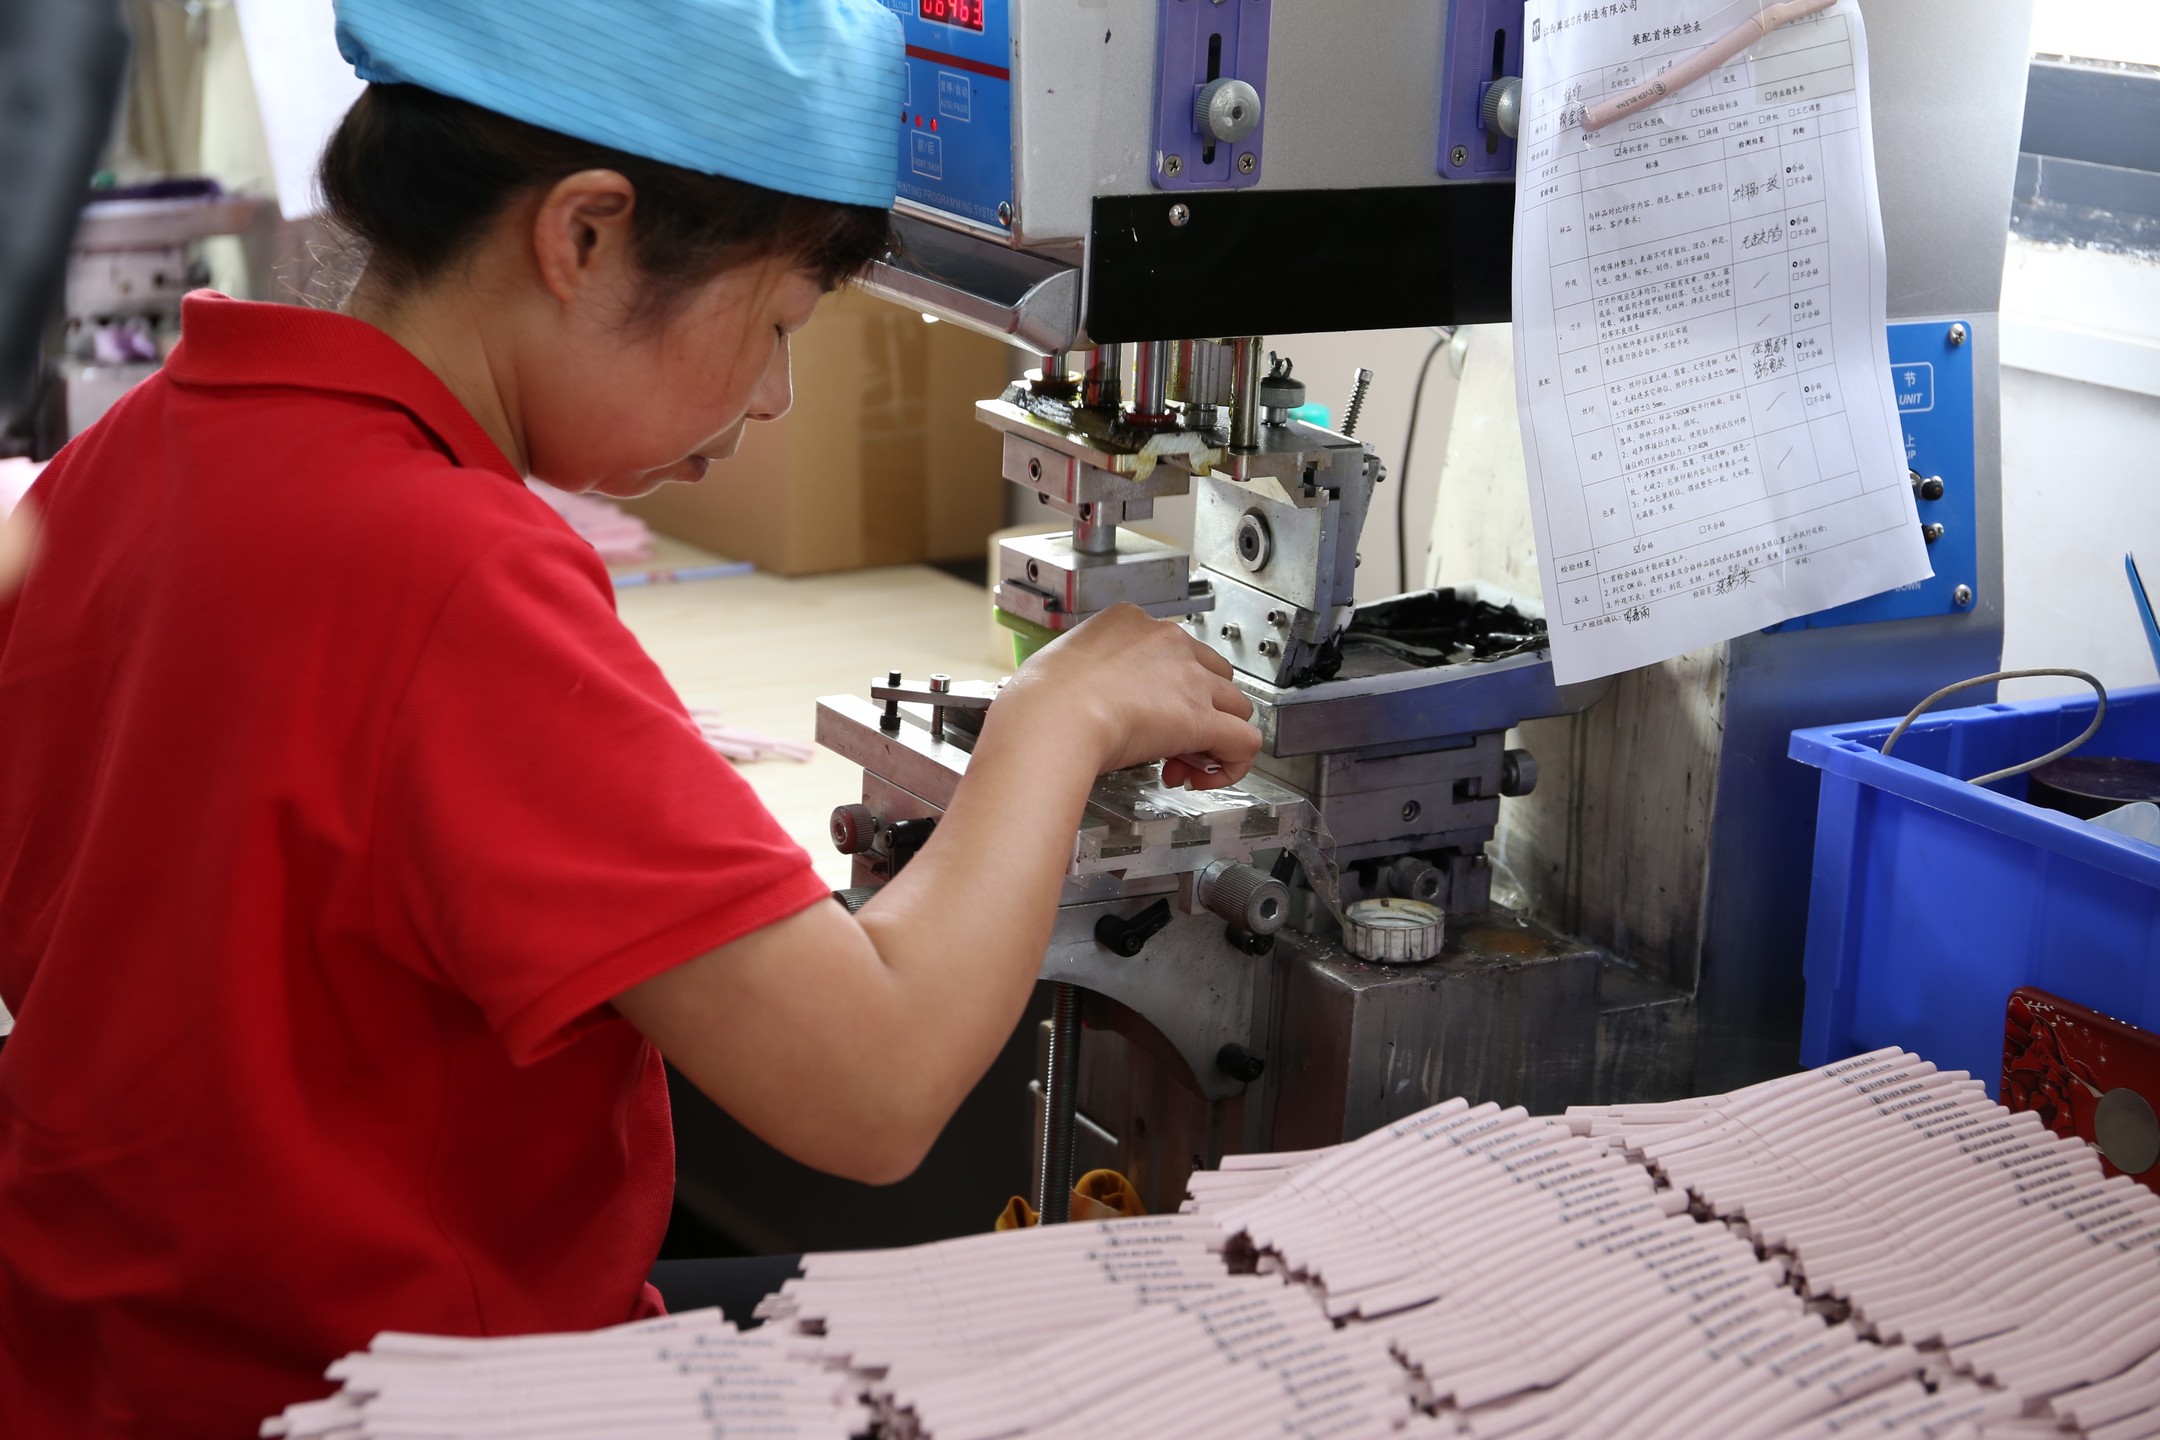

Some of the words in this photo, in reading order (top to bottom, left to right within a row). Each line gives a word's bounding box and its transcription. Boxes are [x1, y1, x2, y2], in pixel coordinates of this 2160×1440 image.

[1632, 21, 1702, 46] 装配首件检验表
[1638, 89, 1654, 100] EVER
[1772, 85, 1805, 98] 作业指导书
[1616, 96, 1638, 109] BILENA
[897, 181, 923, 198] RINTING
[974, 204, 999, 221] SYSTE
[1904, 371, 1917, 387] 节
[1899, 393, 1923, 404] UNIT
[1905, 433, 1916, 447] 上
[1602, 507, 1616, 518] 包装
[1706, 520, 1726, 532] 不合格
[1560, 559, 1592, 574] 检验结果
[1836, 1064, 1852, 1072] EVER
[1853, 1056, 1877, 1067] BILENA
[1853, 1071, 1870, 1080] EVER
[1870, 1064, 1893, 1074] BILENA
[1870, 1079, 1886, 1089] EVER
[1886, 1072, 1909, 1083] BILENA
[1883, 1090, 1900, 1100] EVER
[1900, 1083, 1925, 1094] BILENA
[1891, 1102, 1908, 1111] EVER
[1908, 1095, 1933, 1105] BILENA
[1916, 1108, 1933, 1117] EVER
[1933, 1101, 1959, 1111] BILENA
[1927, 1118, 1944, 1126] EVER
[1945, 1110, 1968, 1120] BILENA
[1969, 1129, 1986, 1138] EVER
[1987, 1122, 2011, 1132] BILENA
